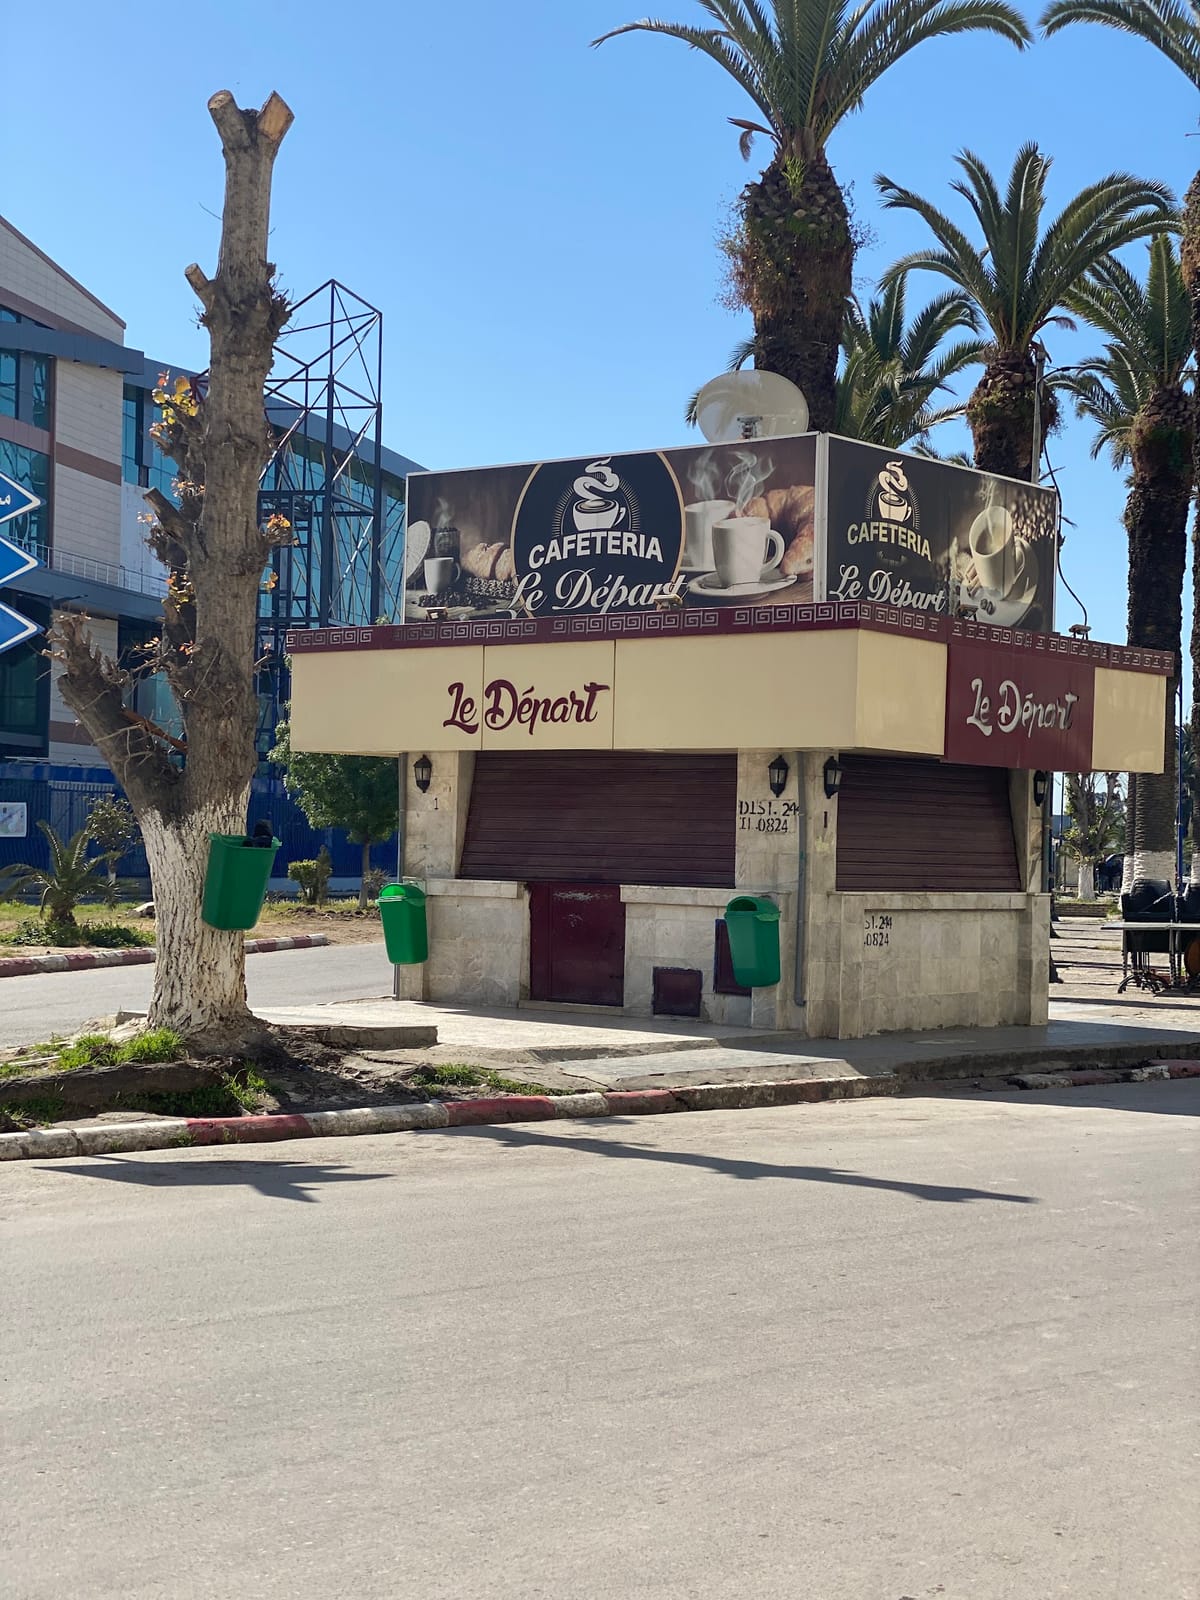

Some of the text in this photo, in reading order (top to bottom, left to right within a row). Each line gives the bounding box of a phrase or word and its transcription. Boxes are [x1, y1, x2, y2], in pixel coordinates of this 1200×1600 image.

[528, 531, 664, 569] CAFETERIA
[846, 521, 932, 562] CAFETERIA
[496, 567, 688, 619] Le Départ
[829, 564, 947, 612] Le Départ
[442, 679, 611, 736] Le Départ
[966, 678, 1080, 738] Le Départ
